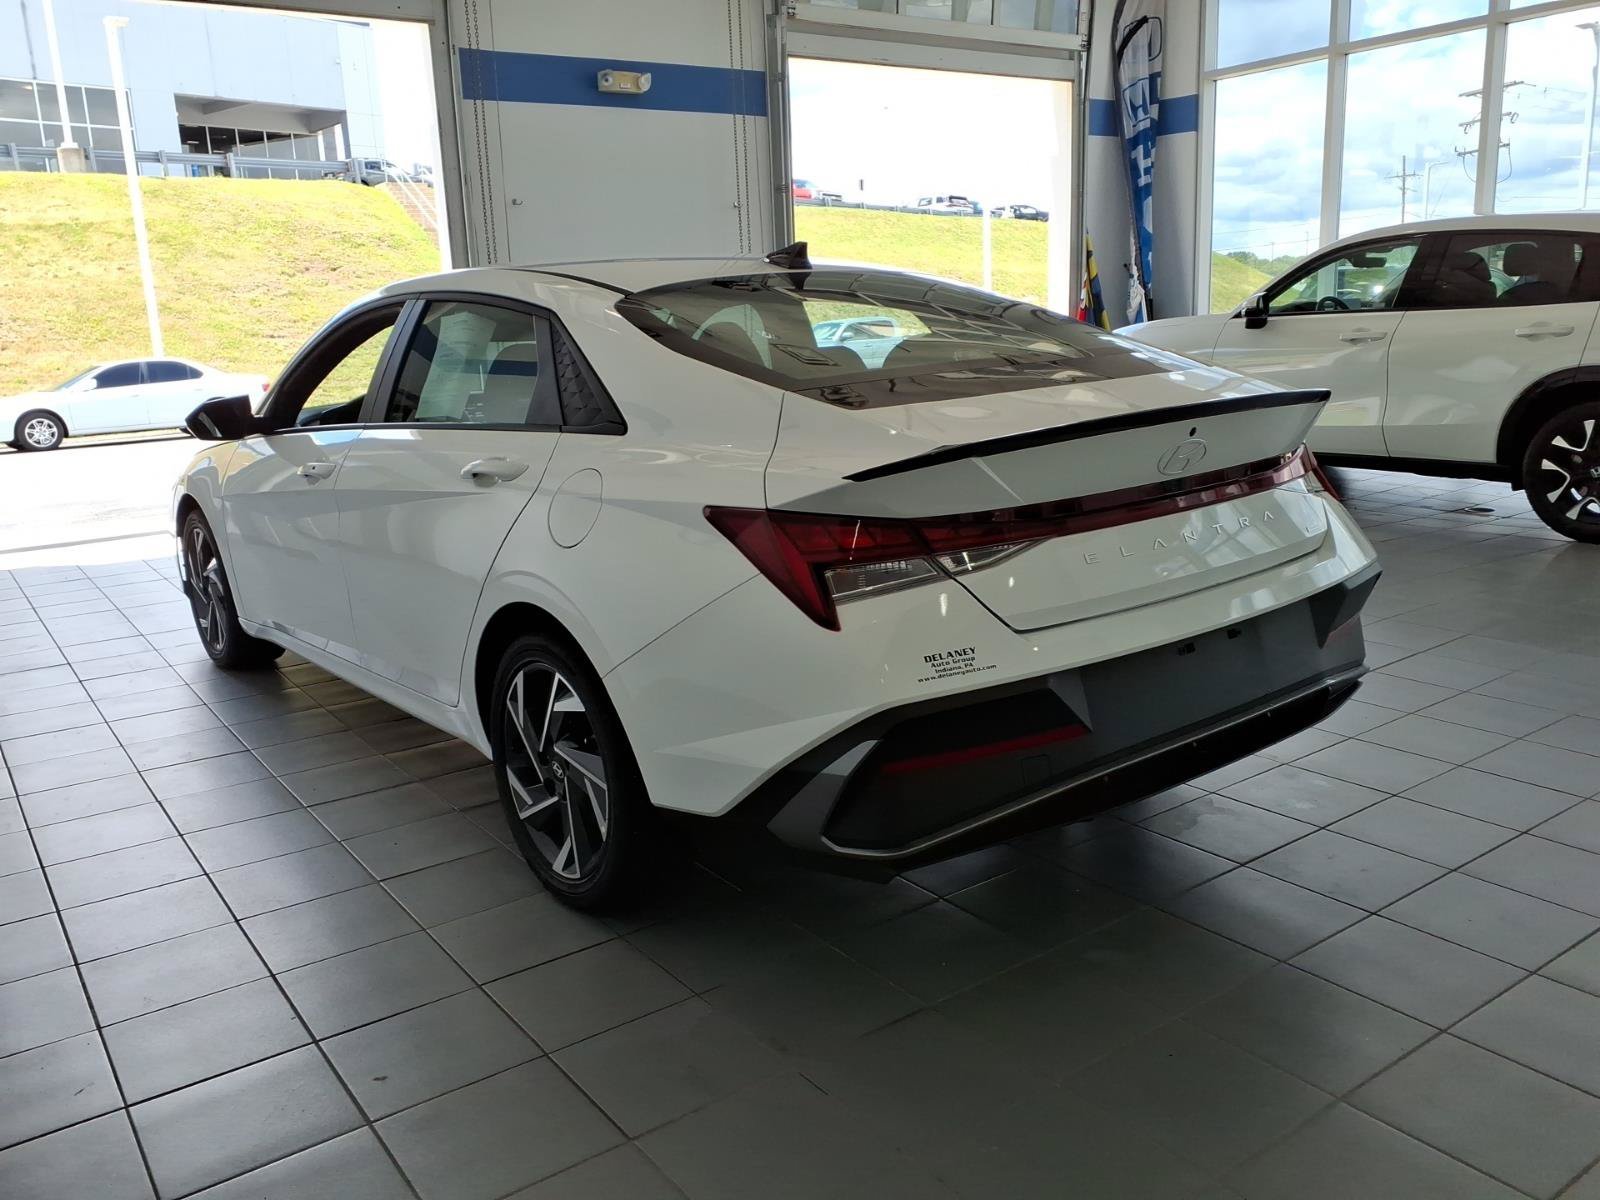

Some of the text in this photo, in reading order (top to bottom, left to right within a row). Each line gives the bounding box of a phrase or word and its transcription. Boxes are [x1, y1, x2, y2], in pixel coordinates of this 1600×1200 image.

[1083, 511, 1275, 565] ELANTRA
[923, 646, 976, 663] DELANEY
[931, 656, 976, 668] Auto Group
[918, 664, 997, 683] www.delaneyauto.com
